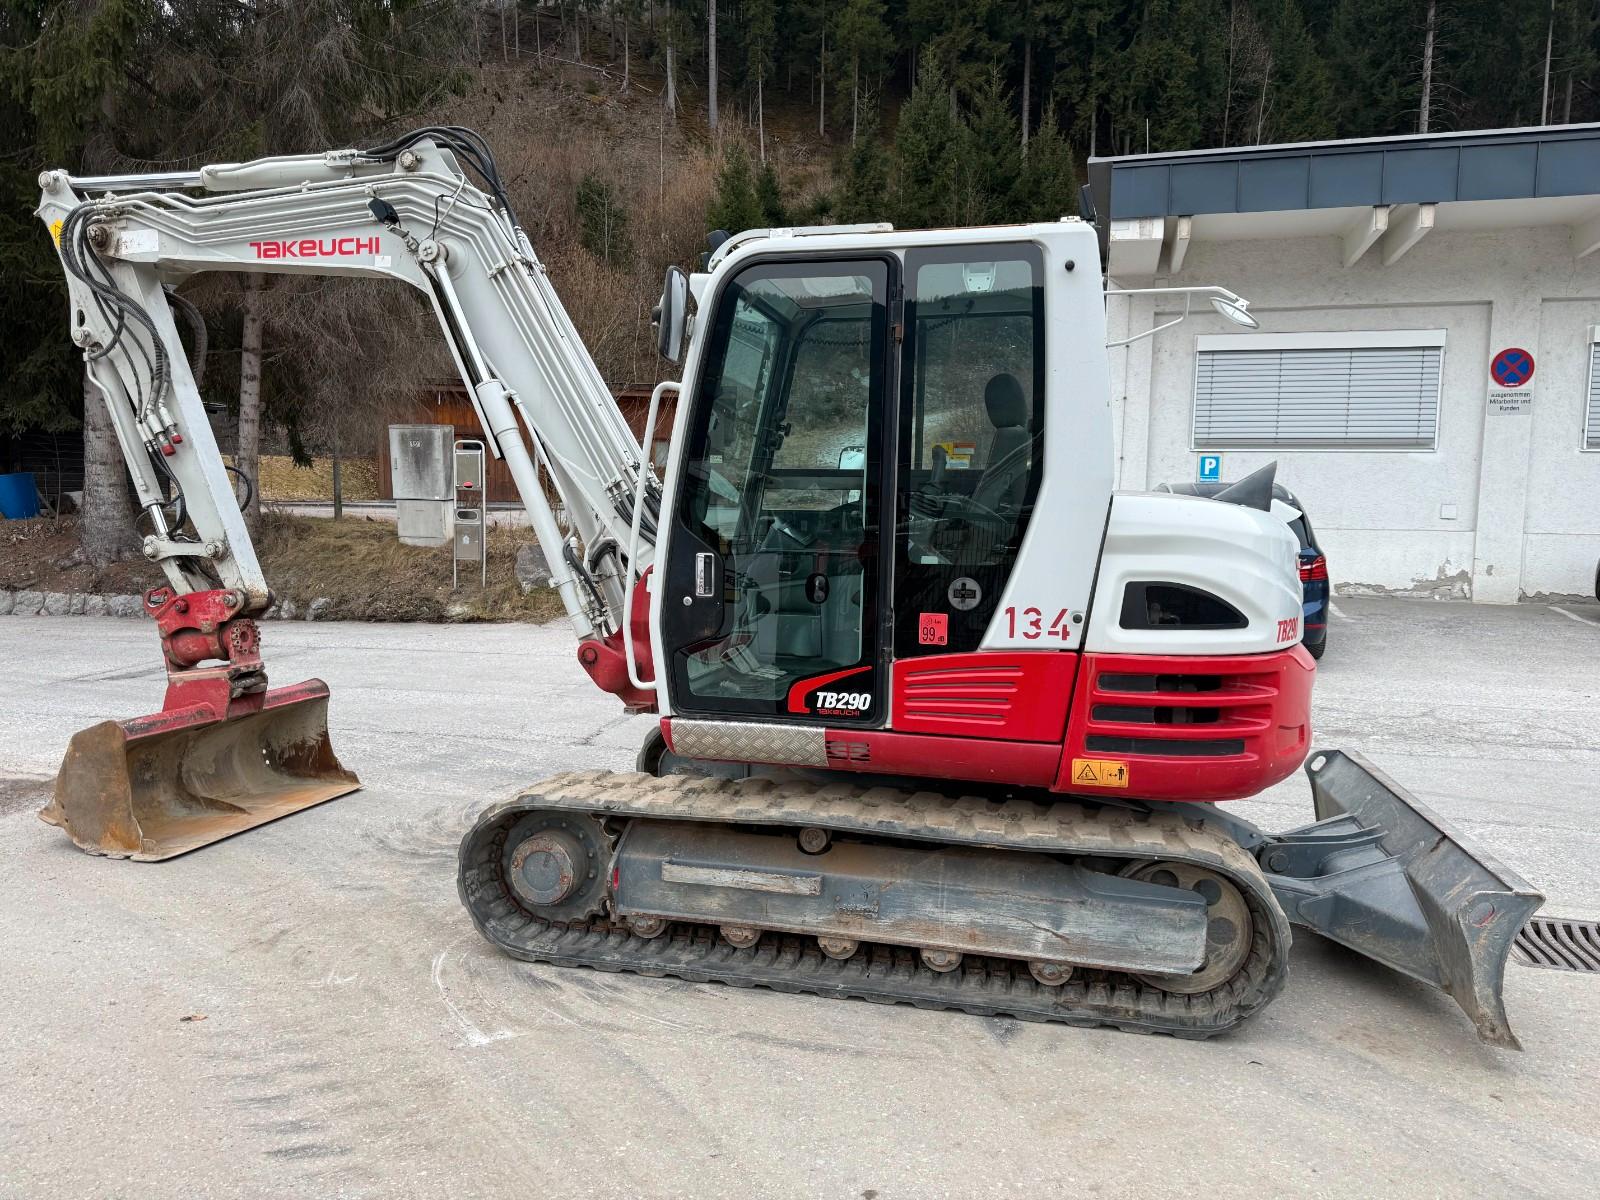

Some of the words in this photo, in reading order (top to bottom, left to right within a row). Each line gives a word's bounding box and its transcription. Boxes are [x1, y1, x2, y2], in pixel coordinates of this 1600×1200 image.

[249, 236, 380, 259] TAKEUCHI
[1204, 458, 1217, 475] P
[1005, 606, 1071, 641] 134
[922, 626, 936, 642] 99
[816, 691, 872, 710] TB290
